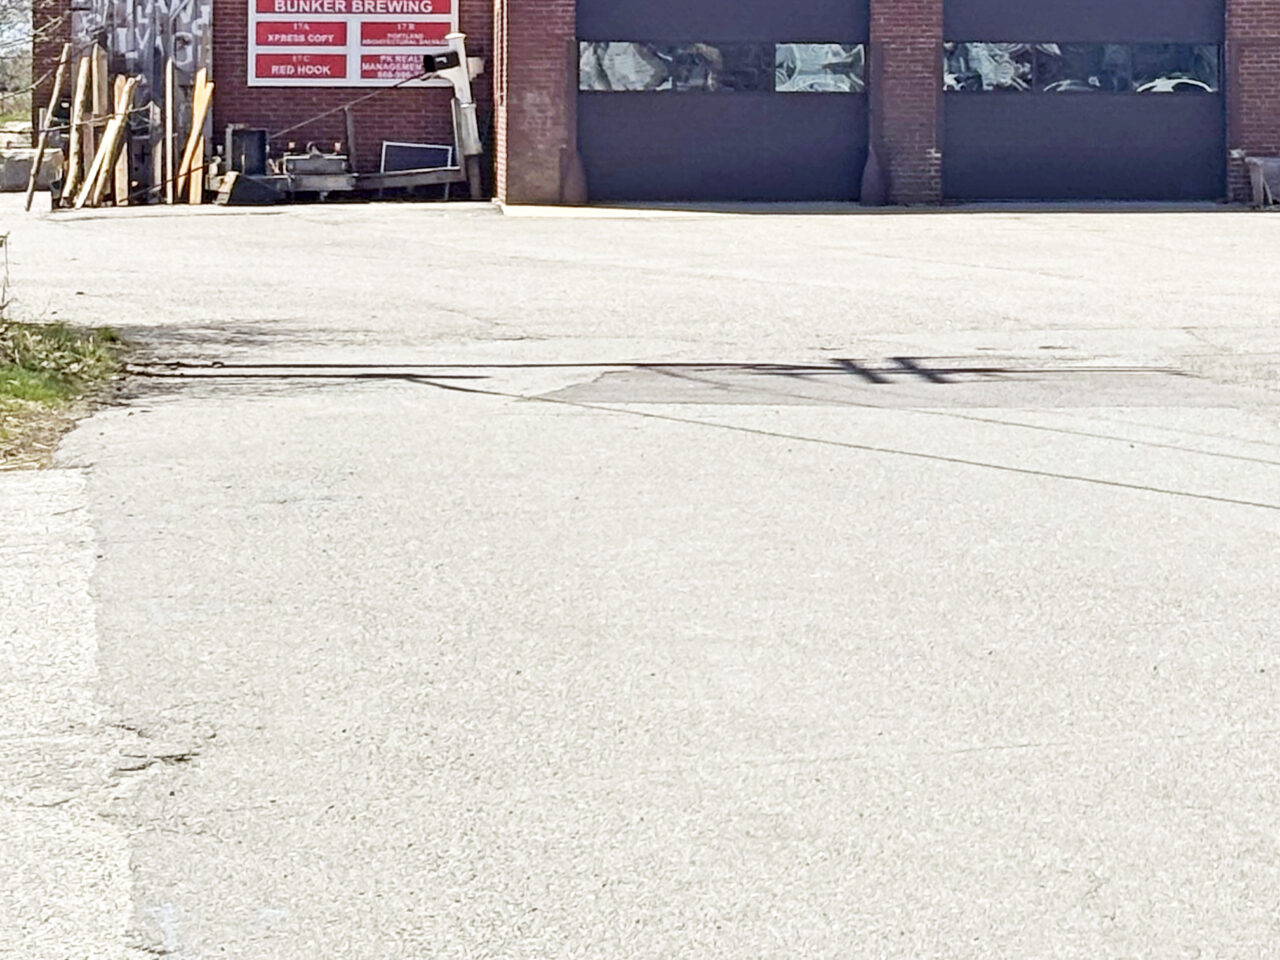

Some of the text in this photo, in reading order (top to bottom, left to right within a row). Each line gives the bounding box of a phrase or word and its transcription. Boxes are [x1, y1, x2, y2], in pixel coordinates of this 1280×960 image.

[274, 0, 433, 13] BUNKER BREWING
[267, 34, 334, 43] XPRESS COPY
[272, 65, 331, 75] RED HOOK
